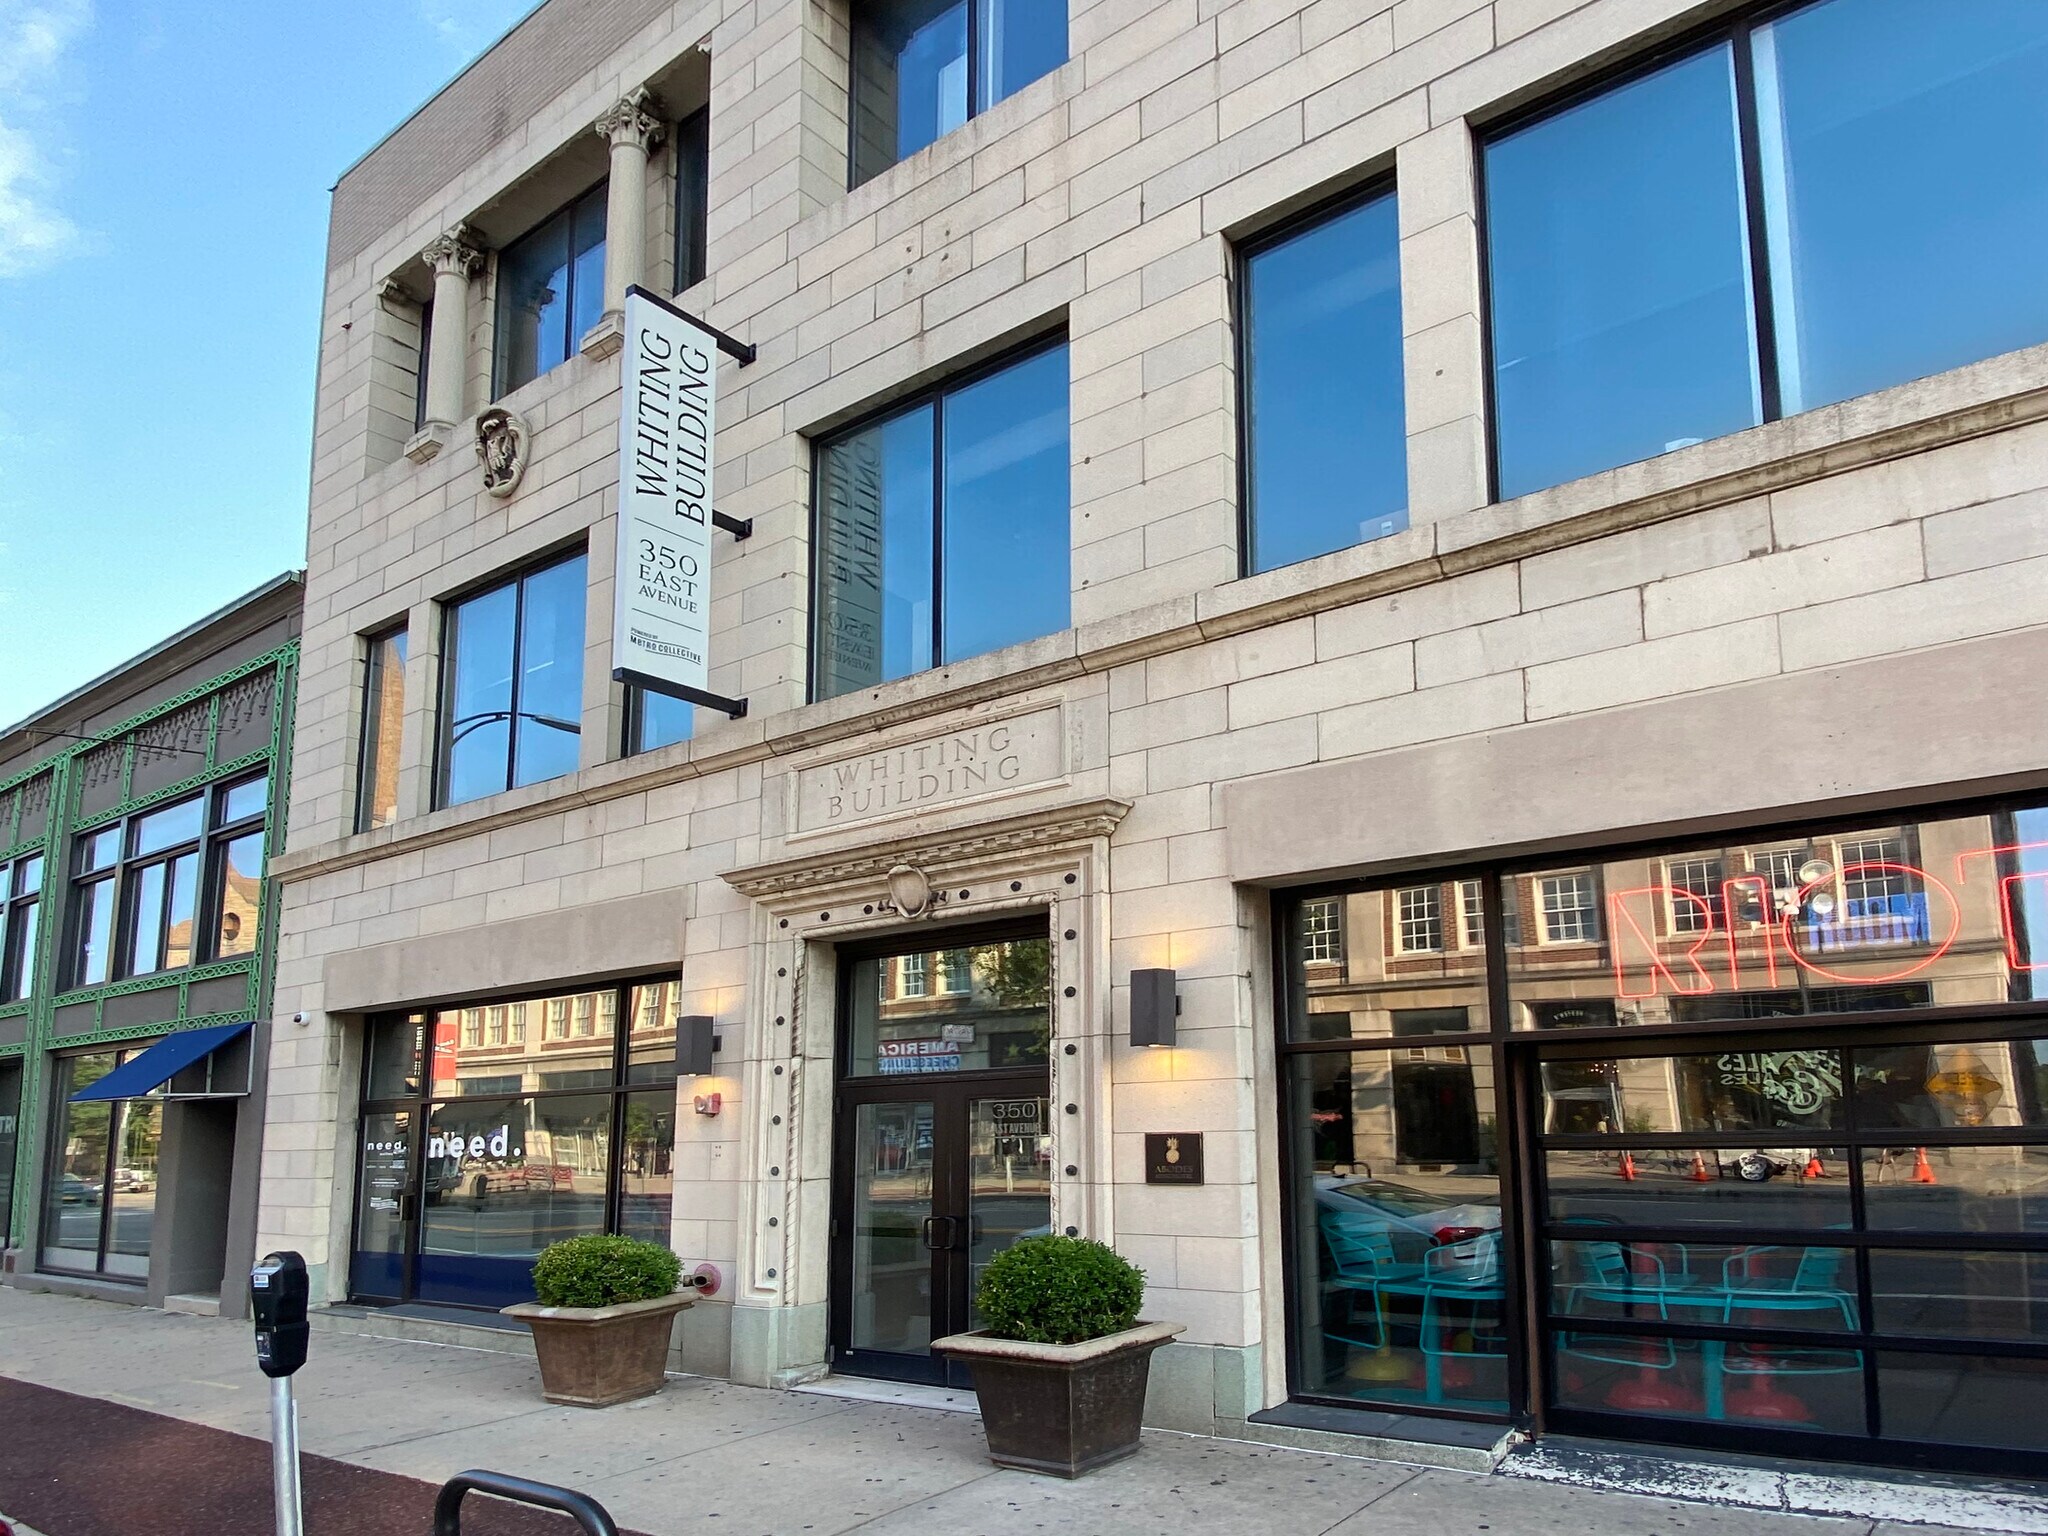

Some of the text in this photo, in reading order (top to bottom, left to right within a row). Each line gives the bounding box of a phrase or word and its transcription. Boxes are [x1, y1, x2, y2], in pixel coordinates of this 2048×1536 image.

[635, 328, 672, 499] WHITING
[675, 344, 710, 526] BUILDING
[640, 539, 698, 577] 350
[639, 563, 698, 597] EAST
[638, 584, 698, 614] AVENUE
[630, 634, 702, 663] METRO COLLECTIVE
[833, 726, 1012, 787] WHITING
[828, 755, 1021, 820] BUILDING
[993, 1102, 1036, 1119] 350
[367, 1140, 407, 1151] need.
[428, 1124, 521, 1159] need.
